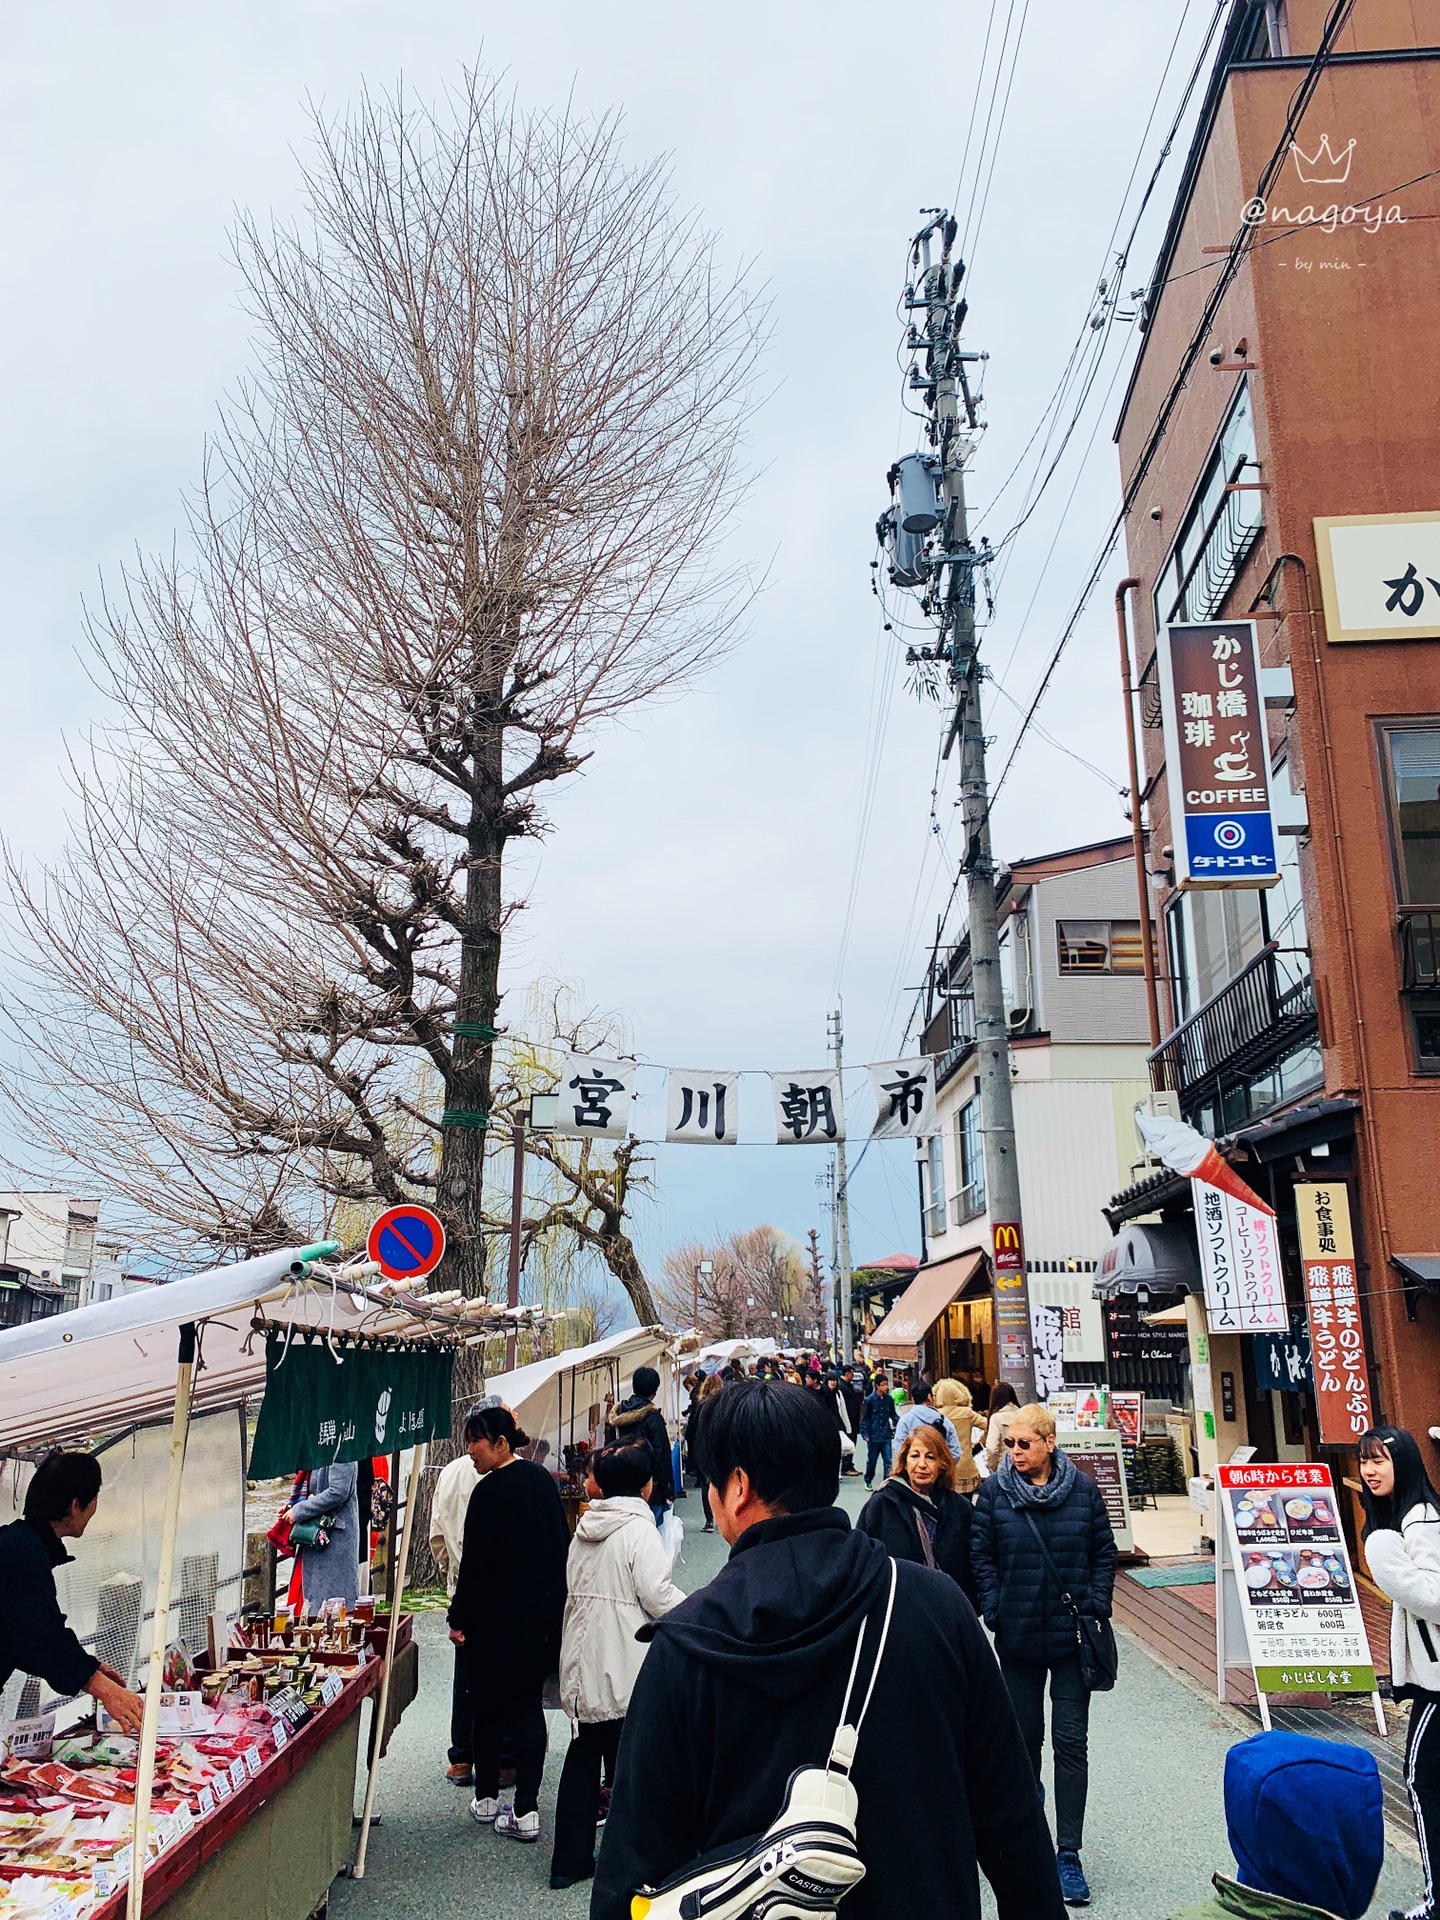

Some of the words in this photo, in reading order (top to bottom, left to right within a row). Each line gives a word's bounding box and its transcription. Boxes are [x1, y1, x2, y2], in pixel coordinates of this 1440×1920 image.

[1211, 634, 1248, 718] かじ橋
[1181, 691, 1216, 748] 珈琲
[1186, 786, 1266, 806] COFFEE
[568, 1067, 927, 1141] 宮川朝市
[1313, 1190, 1337, 1254] お食事処
[1203, 1192, 1236, 1326] 地酒ソフトクリーム
[1234, 1206, 1263, 1324] コーヒーソフトクリーム
[1252, 1219, 1279, 1325] 桃ソフトクリーム
[1307, 1266, 1341, 1393] 飛騨牛うどん
[1331, 1265, 1370, 1436] 飛騨牛のどんぶり
[1228, 1469, 1324, 1485] 朝6時から営業
[1317, 1609, 1343, 1619] 600円
[1319, 1620, 1345, 1629] 600円
[1281, 1670, 1353, 1685] かじばし食堂
